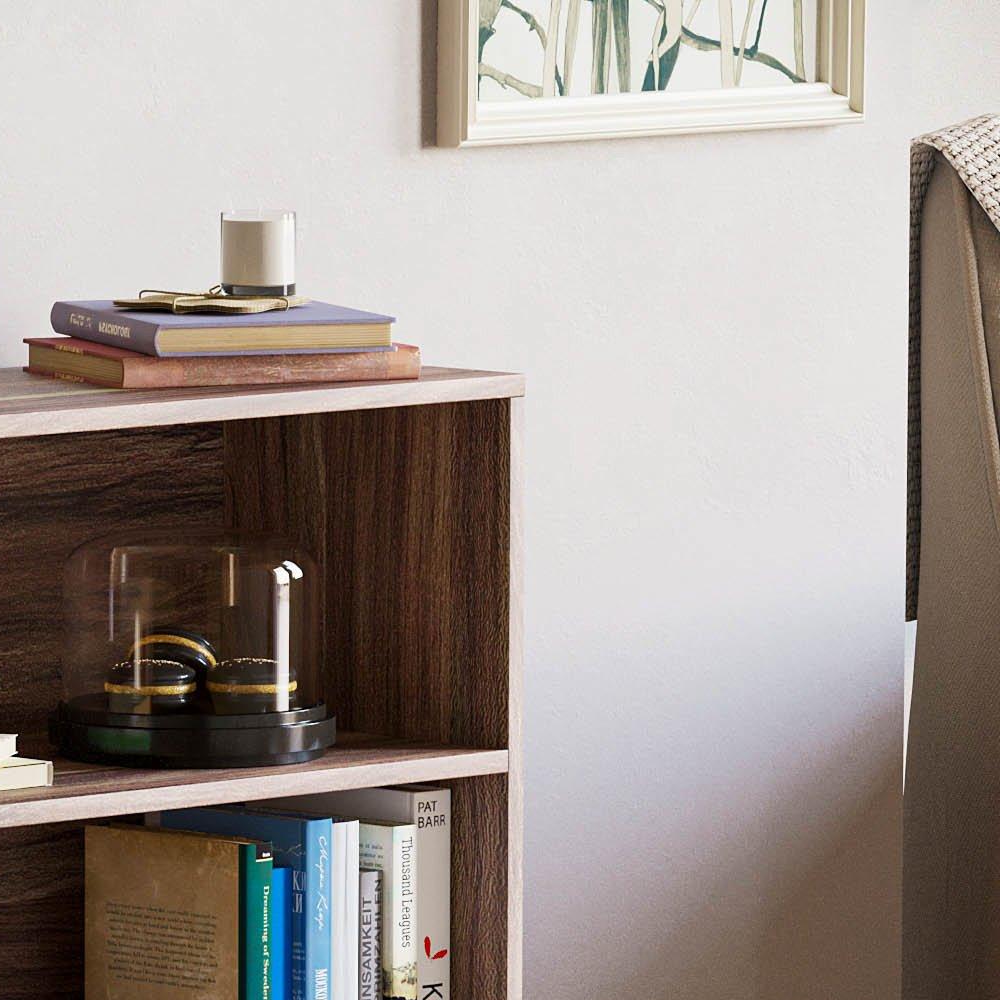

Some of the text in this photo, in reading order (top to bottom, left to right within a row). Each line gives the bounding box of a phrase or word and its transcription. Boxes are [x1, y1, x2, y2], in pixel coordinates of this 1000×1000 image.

[417, 800, 438, 813] PAT
[417, 814, 446, 829] BARR
[398, 836, 413, 949] Thousand Leagues
[262, 885, 270, 942] Dreaming
[263, 944, 270, 958] of
